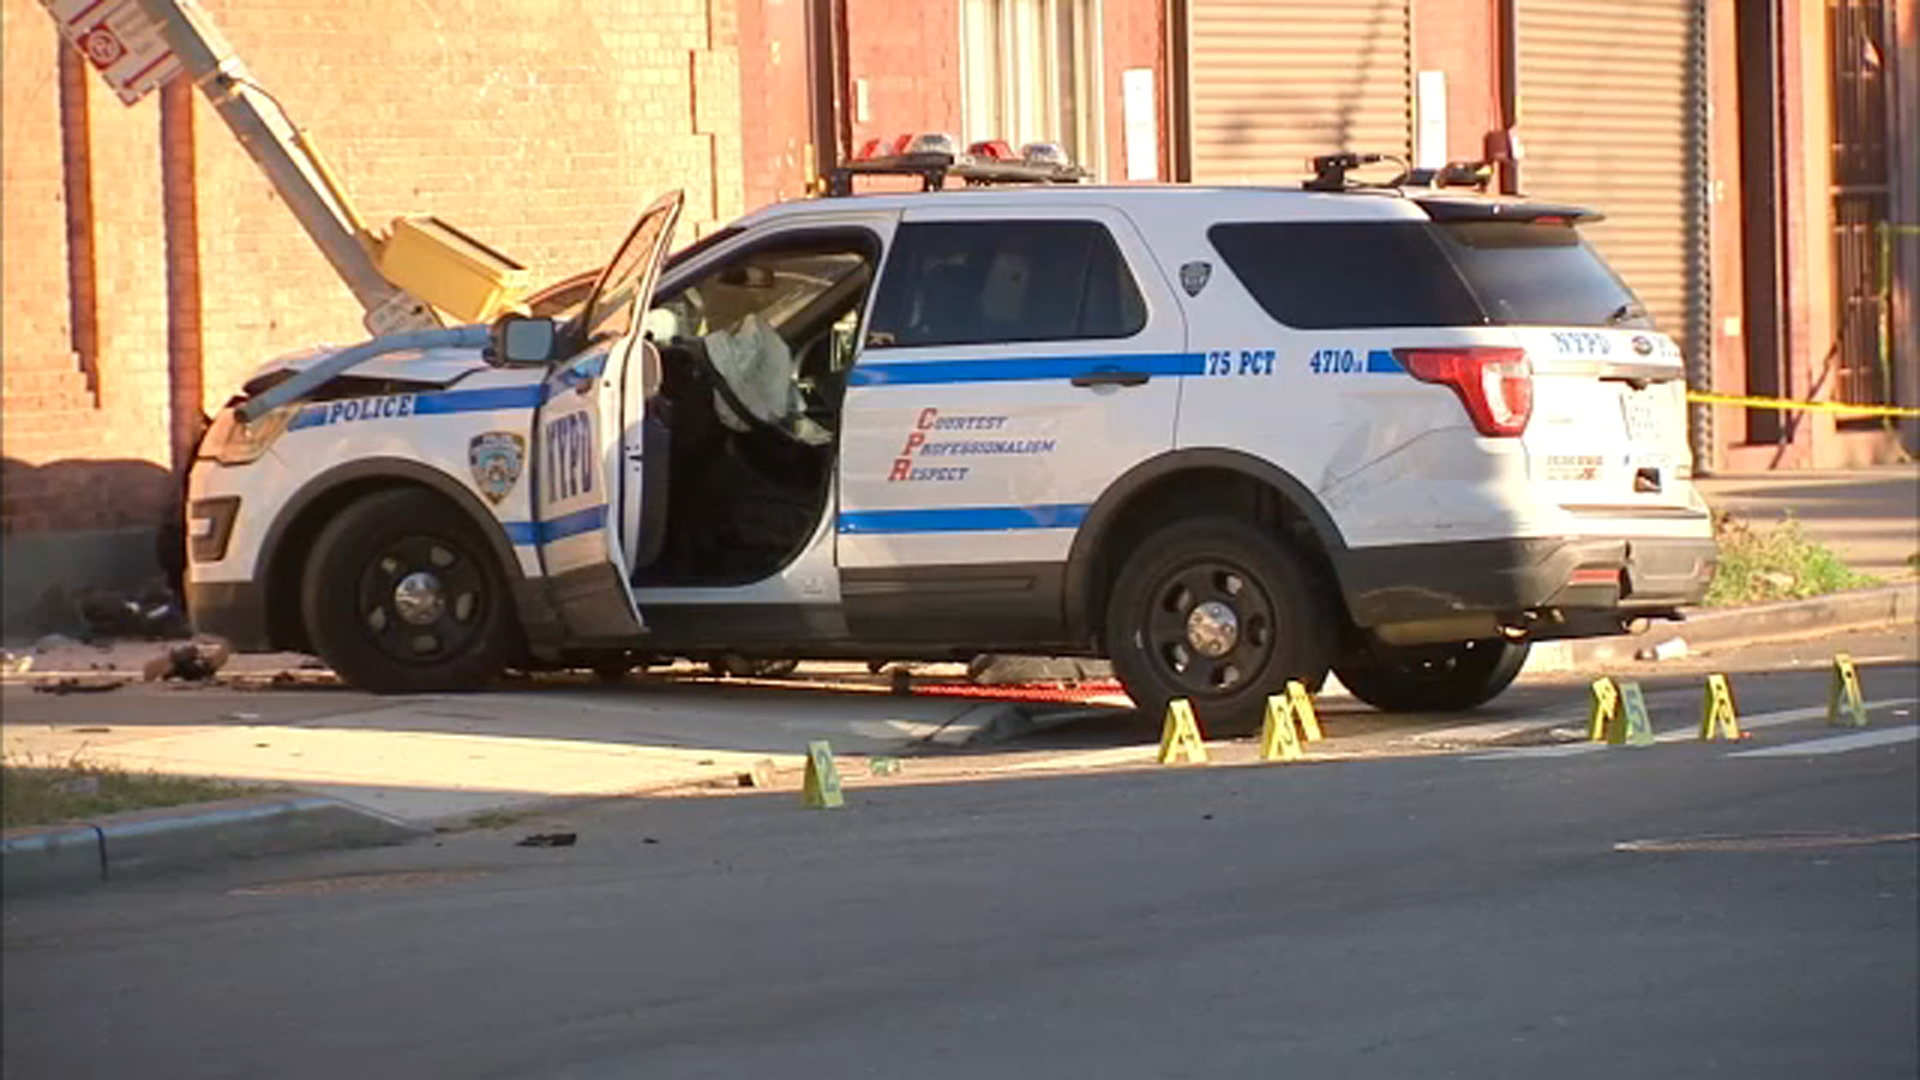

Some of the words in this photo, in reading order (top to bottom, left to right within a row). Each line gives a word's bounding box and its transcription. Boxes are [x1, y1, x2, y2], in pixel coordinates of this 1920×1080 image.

[1209, 351, 1231, 375] 75
[1238, 351, 1276, 375] PCT
[329, 395, 412, 424] POLICE
[547, 411, 591, 503] NYPD
